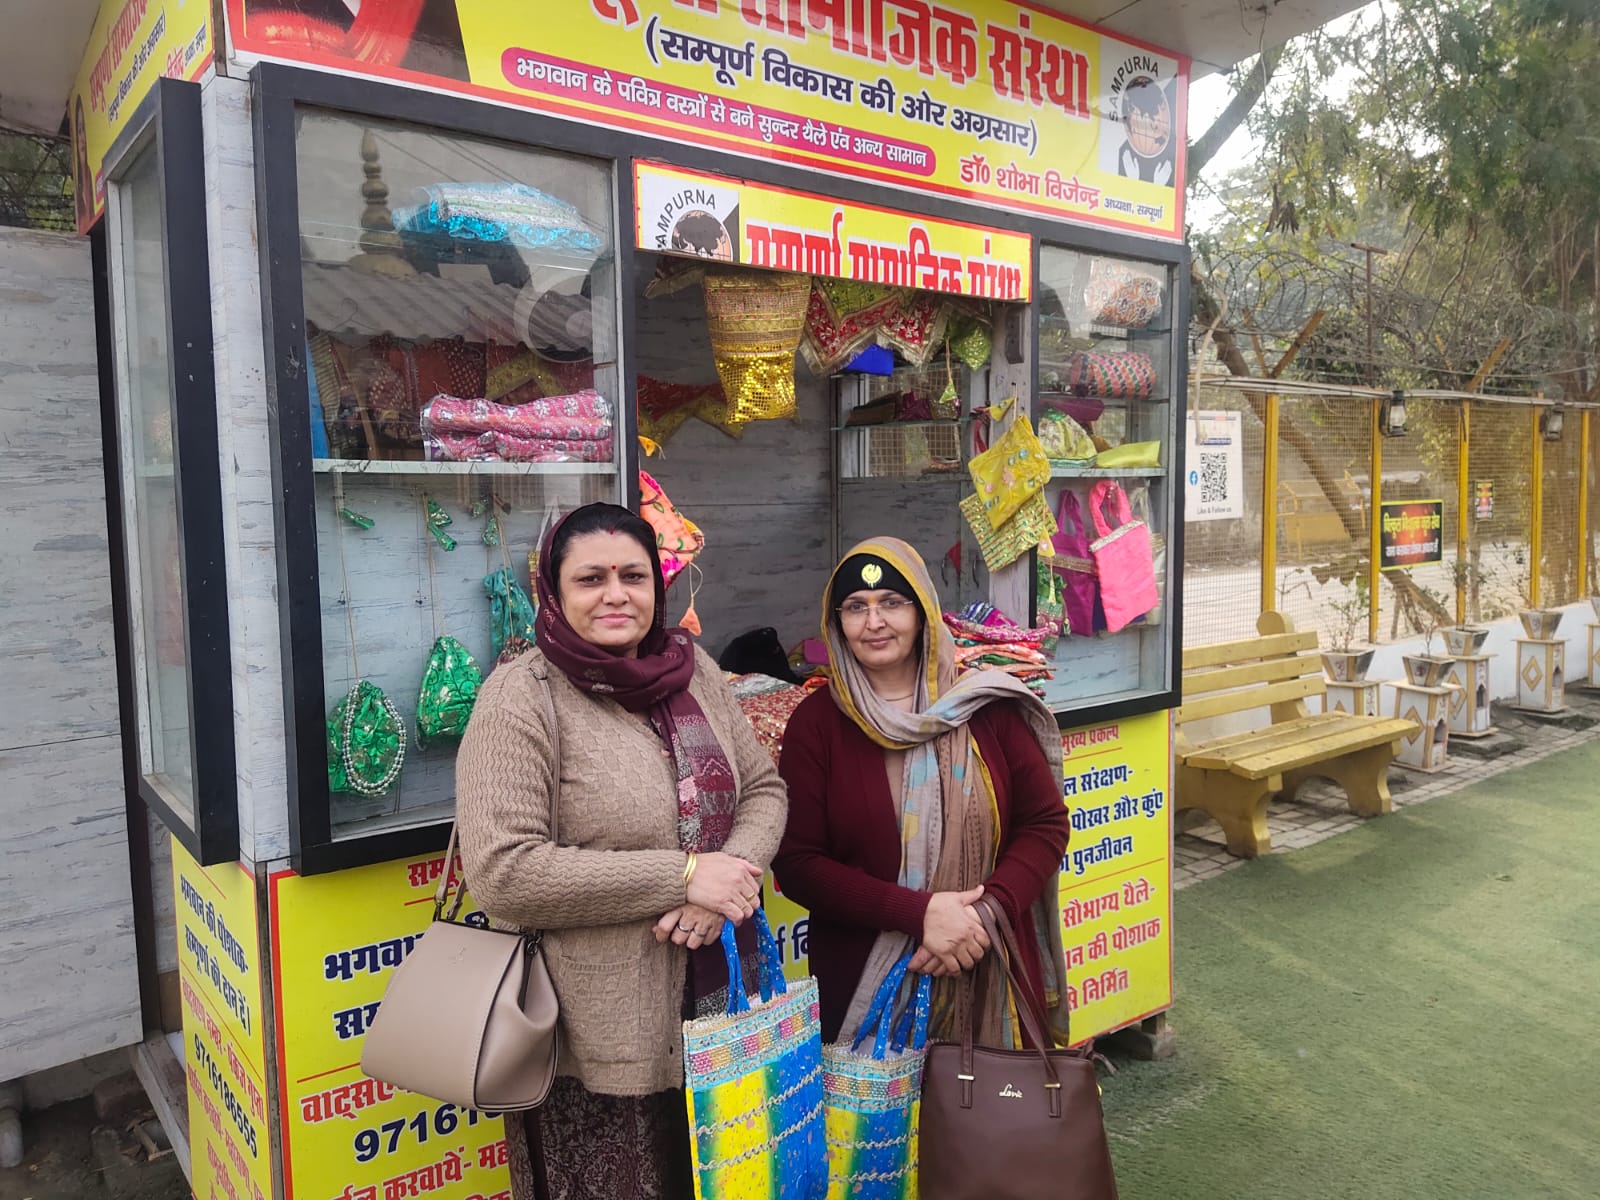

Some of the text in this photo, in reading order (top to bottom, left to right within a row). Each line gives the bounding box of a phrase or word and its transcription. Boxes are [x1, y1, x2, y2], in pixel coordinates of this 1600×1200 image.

[986, 13, 1091, 119] संस्था
[1108, 55, 1160, 122] SAMPURNA
[516, 57, 588, 91] भगवान
[592, 70, 612, 97] के
[617, 77, 662, 109] पवित्र
[665, 93, 709, 119] वस्त्रों
[710, 98, 726, 123] से
[729, 106, 754, 130] बने
[758, 113, 799, 143] सुन्दर
[802, 119, 828, 147] थैले
[854, 138, 882, 159] अन्य
[886, 144, 927, 168] सामान
[762, 48, 854, 103] विकास
[860, 79, 895, 113] की
[901, 91, 947, 127] ओर
[951, 108, 1038, 156] अग्रसार)
[996, 162, 1041, 195] शोभा
[1044, 171, 1102, 210] विजेन्द्र
[655, 188, 716, 248] AMPURNA
[1089, 725, 1119, 745] प्रकल्प
[1072, 807, 1109, 831] पोखर
[1113, 795, 1138, 821] और
[1063, 899, 1120, 928] सौभाग्य
[1088, 932, 1108, 960] की
[1112, 917, 1160, 950] पोशाक
[1083, 967, 1128, 1006] निर्मित
[195, 1033, 257, 1158] 9716186555
